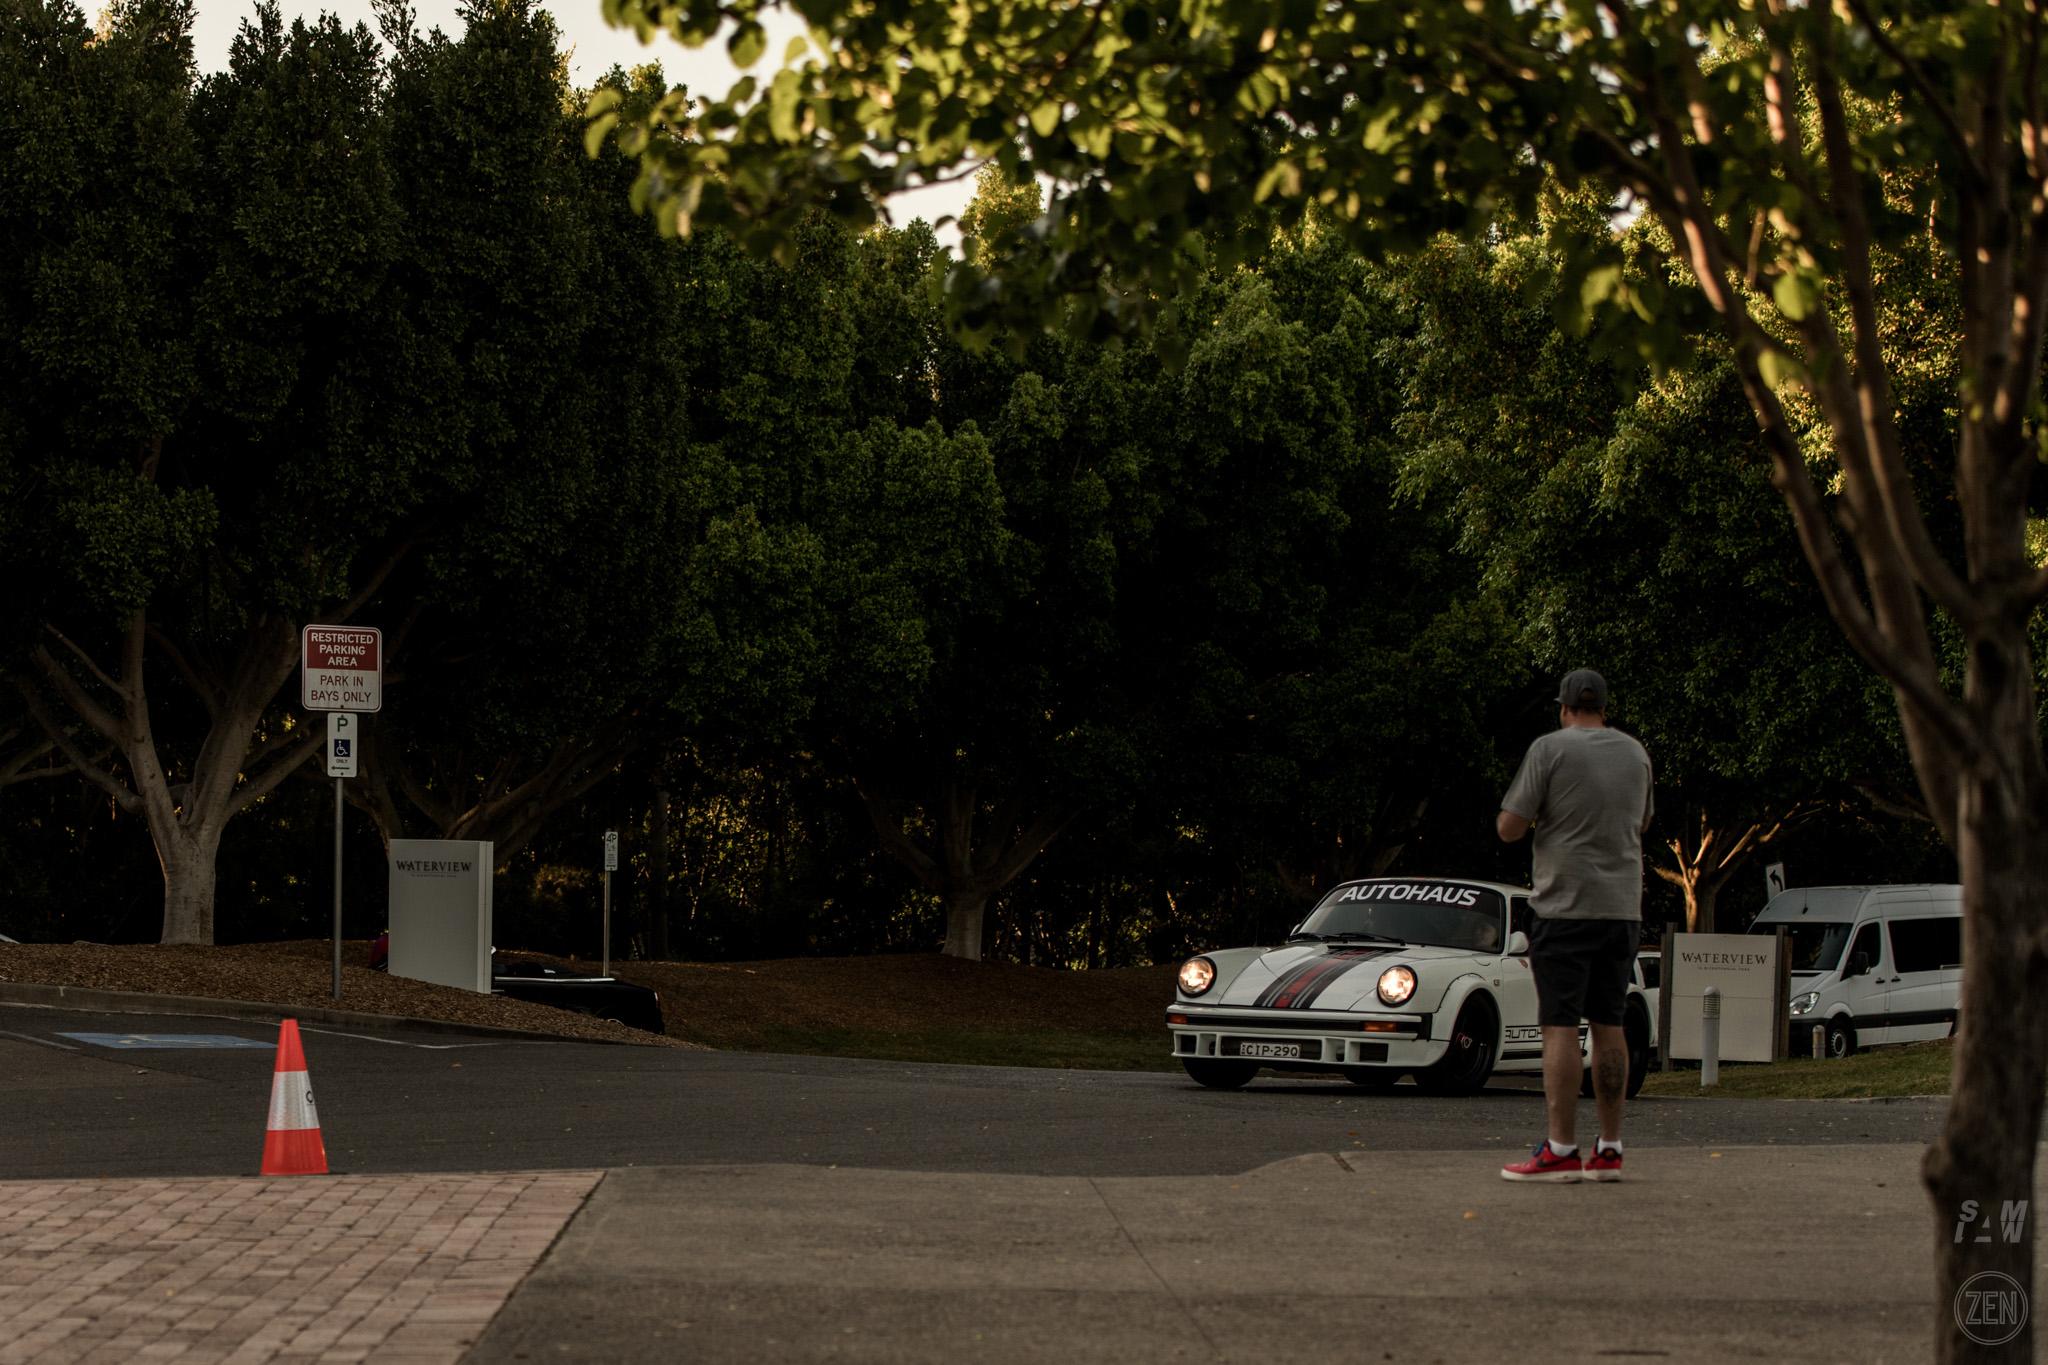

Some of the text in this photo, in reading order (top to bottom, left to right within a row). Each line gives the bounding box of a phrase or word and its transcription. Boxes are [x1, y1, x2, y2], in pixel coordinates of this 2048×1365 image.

[311, 632, 374, 644] RESTRICTED
[319, 644, 366, 656] PARKING
[327, 656, 358, 667] AREA
[320, 675, 364, 687] PARK IN
[311, 690, 372, 702] BAYS ONLY
[337, 717, 348, 732] P
[396, 861, 472, 872] WATERVIEW
[1338, 884, 1481, 906] AUTOHAUS
[1682, 952, 1767, 965] WATERVIEW
[1505, 1029, 1542, 1039] AUTOH
